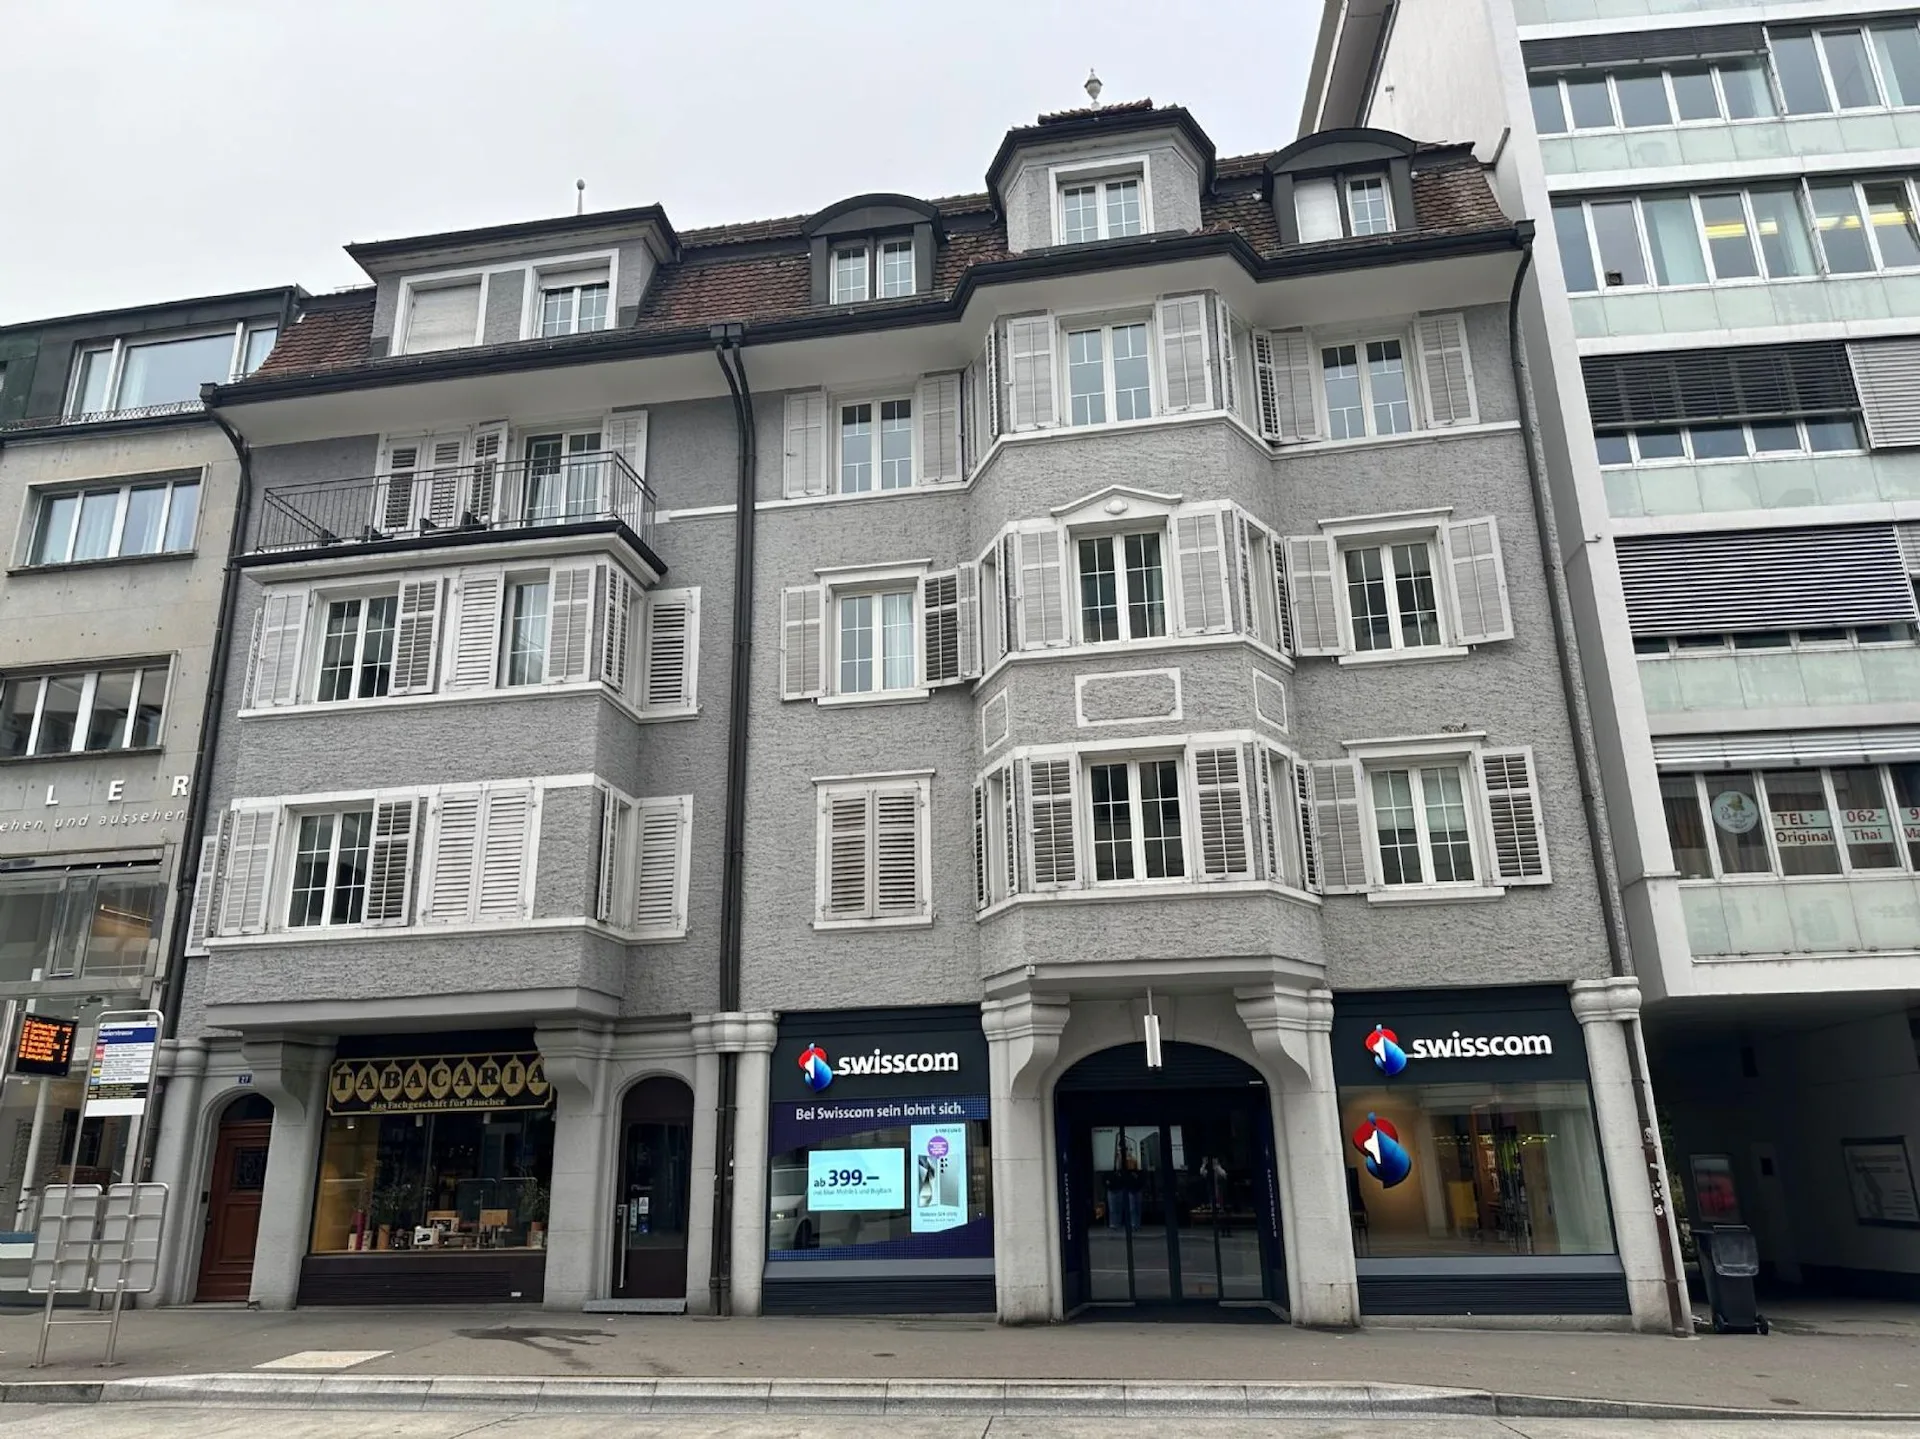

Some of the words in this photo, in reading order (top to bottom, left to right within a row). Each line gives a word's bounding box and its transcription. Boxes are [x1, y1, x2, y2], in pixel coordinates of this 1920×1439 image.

[55, 813, 90, 829] und
[99, 809, 186, 826] aussehen
[1777, 812, 1815, 826] TEL:
[1846, 809, 1882, 823] 062-
[1775, 829, 1833, 845] Original
[1852, 828, 1883, 840] Thai
[1411, 1031, 1553, 1059] swisscom
[837, 1048, 959, 1076] swisscom
[332, 1062, 547, 1092] TABACARIA
[387, 1099, 448, 1111] Fachgeschäft
[449, 1099, 465, 1108] für
[466, 1097, 507, 1107] Raucher
[796, 1106, 815, 1121] Bei
[817, 1105, 874, 1119] Swisscom
[876, 1104, 901, 1118] sein
[903, 1103, 936, 1117] lohnt
[938, 1102, 966, 1116] sich.
[813, 1178, 826, 1188] ab
